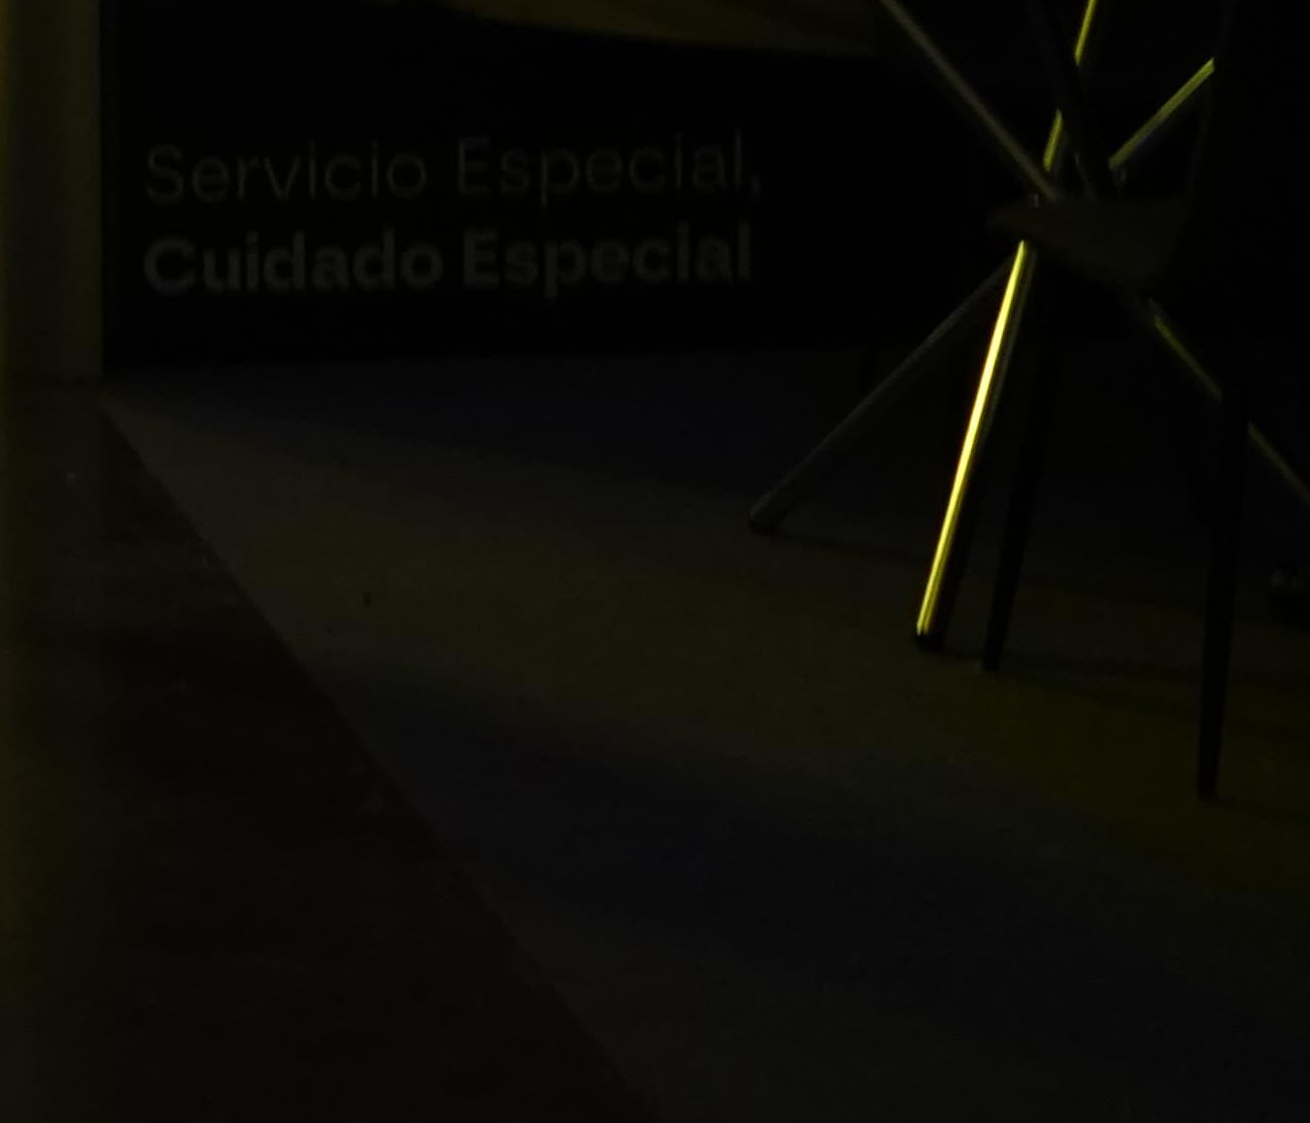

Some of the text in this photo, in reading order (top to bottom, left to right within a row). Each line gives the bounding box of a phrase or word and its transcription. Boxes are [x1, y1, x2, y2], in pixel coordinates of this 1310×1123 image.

[145, 126, 762, 214] Servicio Especial,
[143, 214, 755, 304] Cuidado Especial
